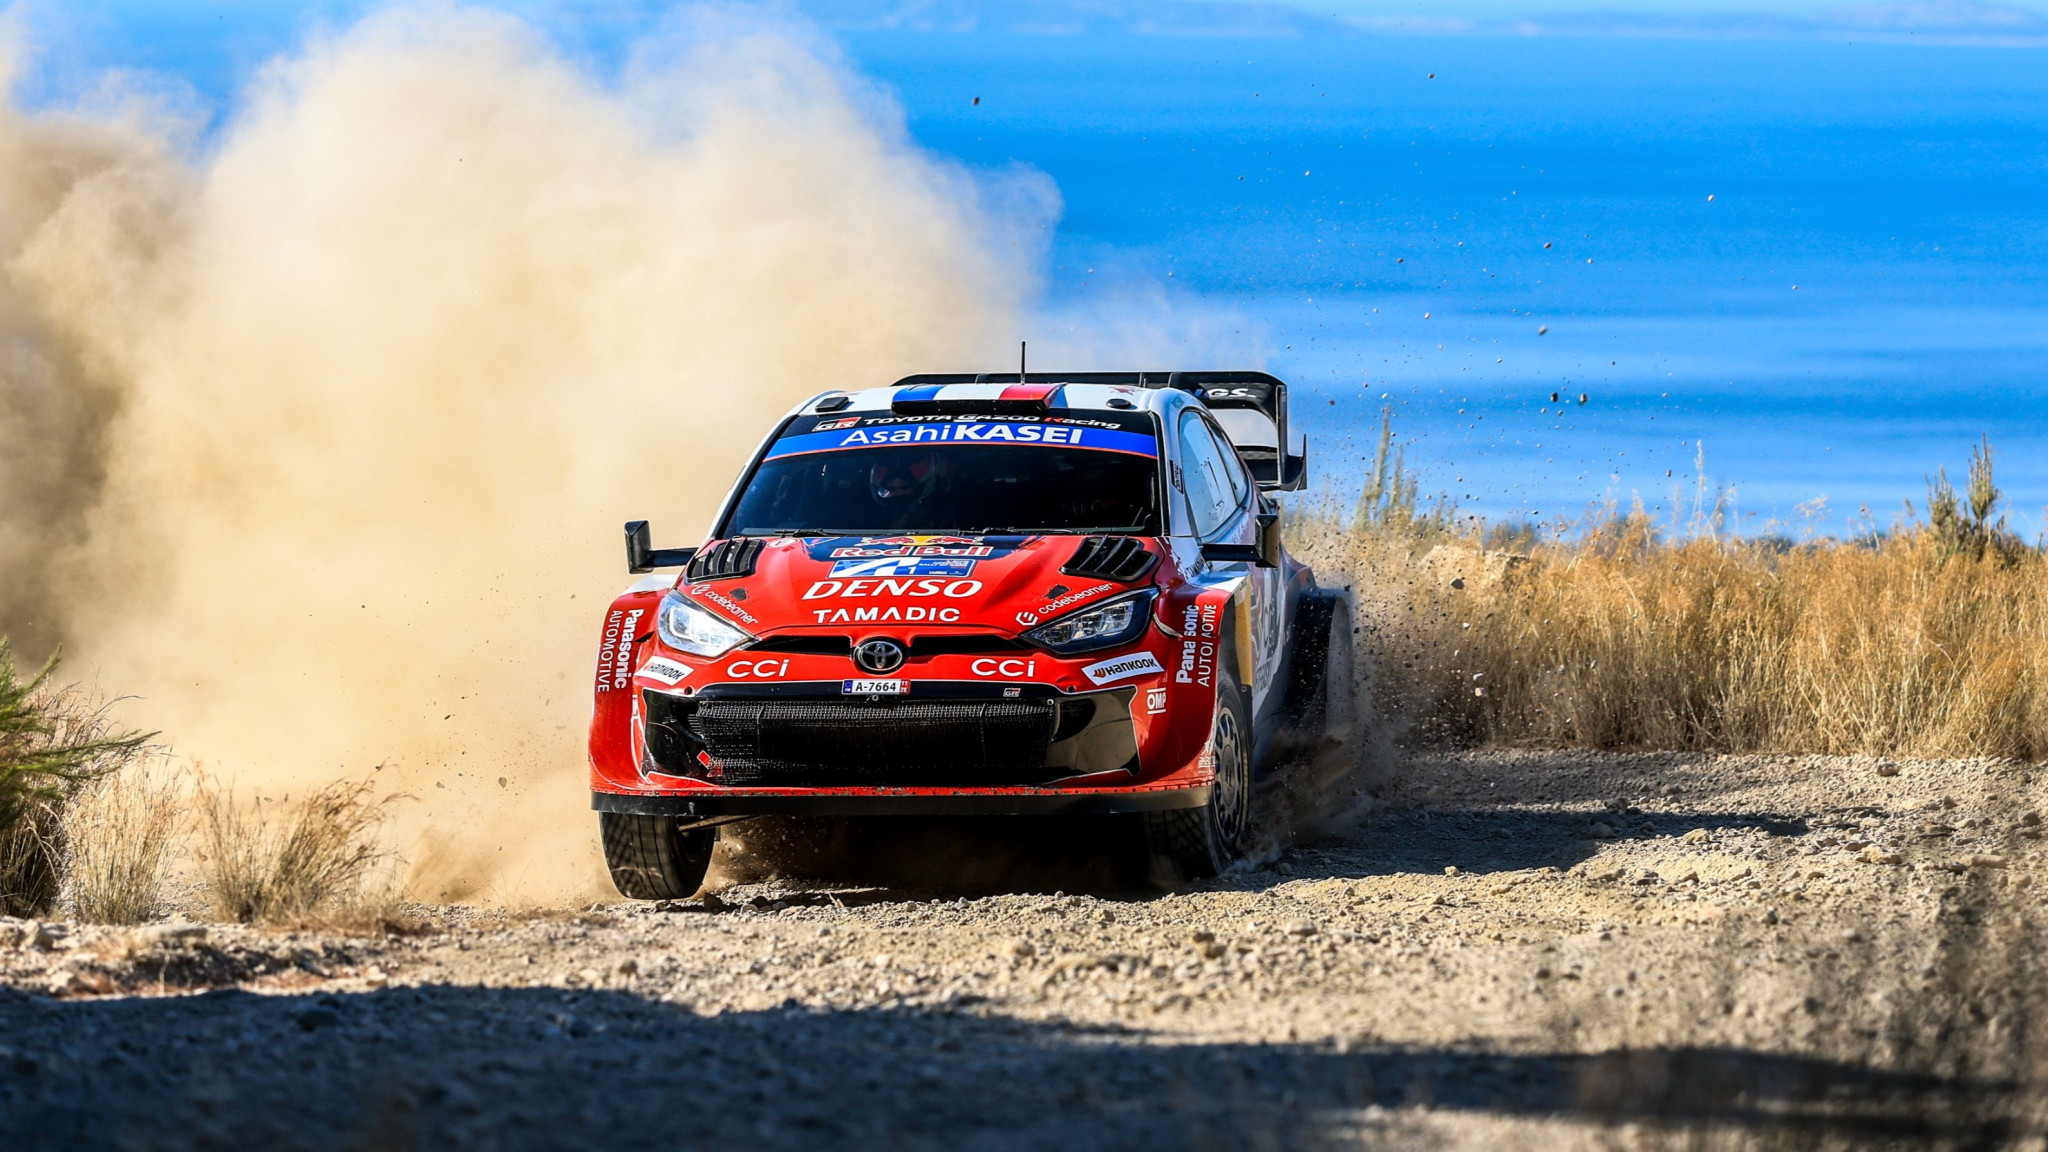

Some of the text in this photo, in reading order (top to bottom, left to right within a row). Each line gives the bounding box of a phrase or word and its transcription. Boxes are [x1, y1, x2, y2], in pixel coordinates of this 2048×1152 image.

[814, 413, 1121, 431] GR TOYOTA GAZOO Racing
[839, 424, 1083, 446] Asahi KASEI
[830, 545, 994, 558] Red Bull
[908, 566, 917, 575] 1
[801, 579, 983, 600] DENSO
[1038, 582, 1112, 615] codebeamer
[705, 590, 759, 624] codebeamer
[813, 606, 961, 624] TAMADIC
[597, 610, 624, 692] AUTOMOTIVE
[614, 608, 645, 689] Panasonic
[855, 681, 897, 692] A-7664
[1147, 691, 1167, 710] OMP
